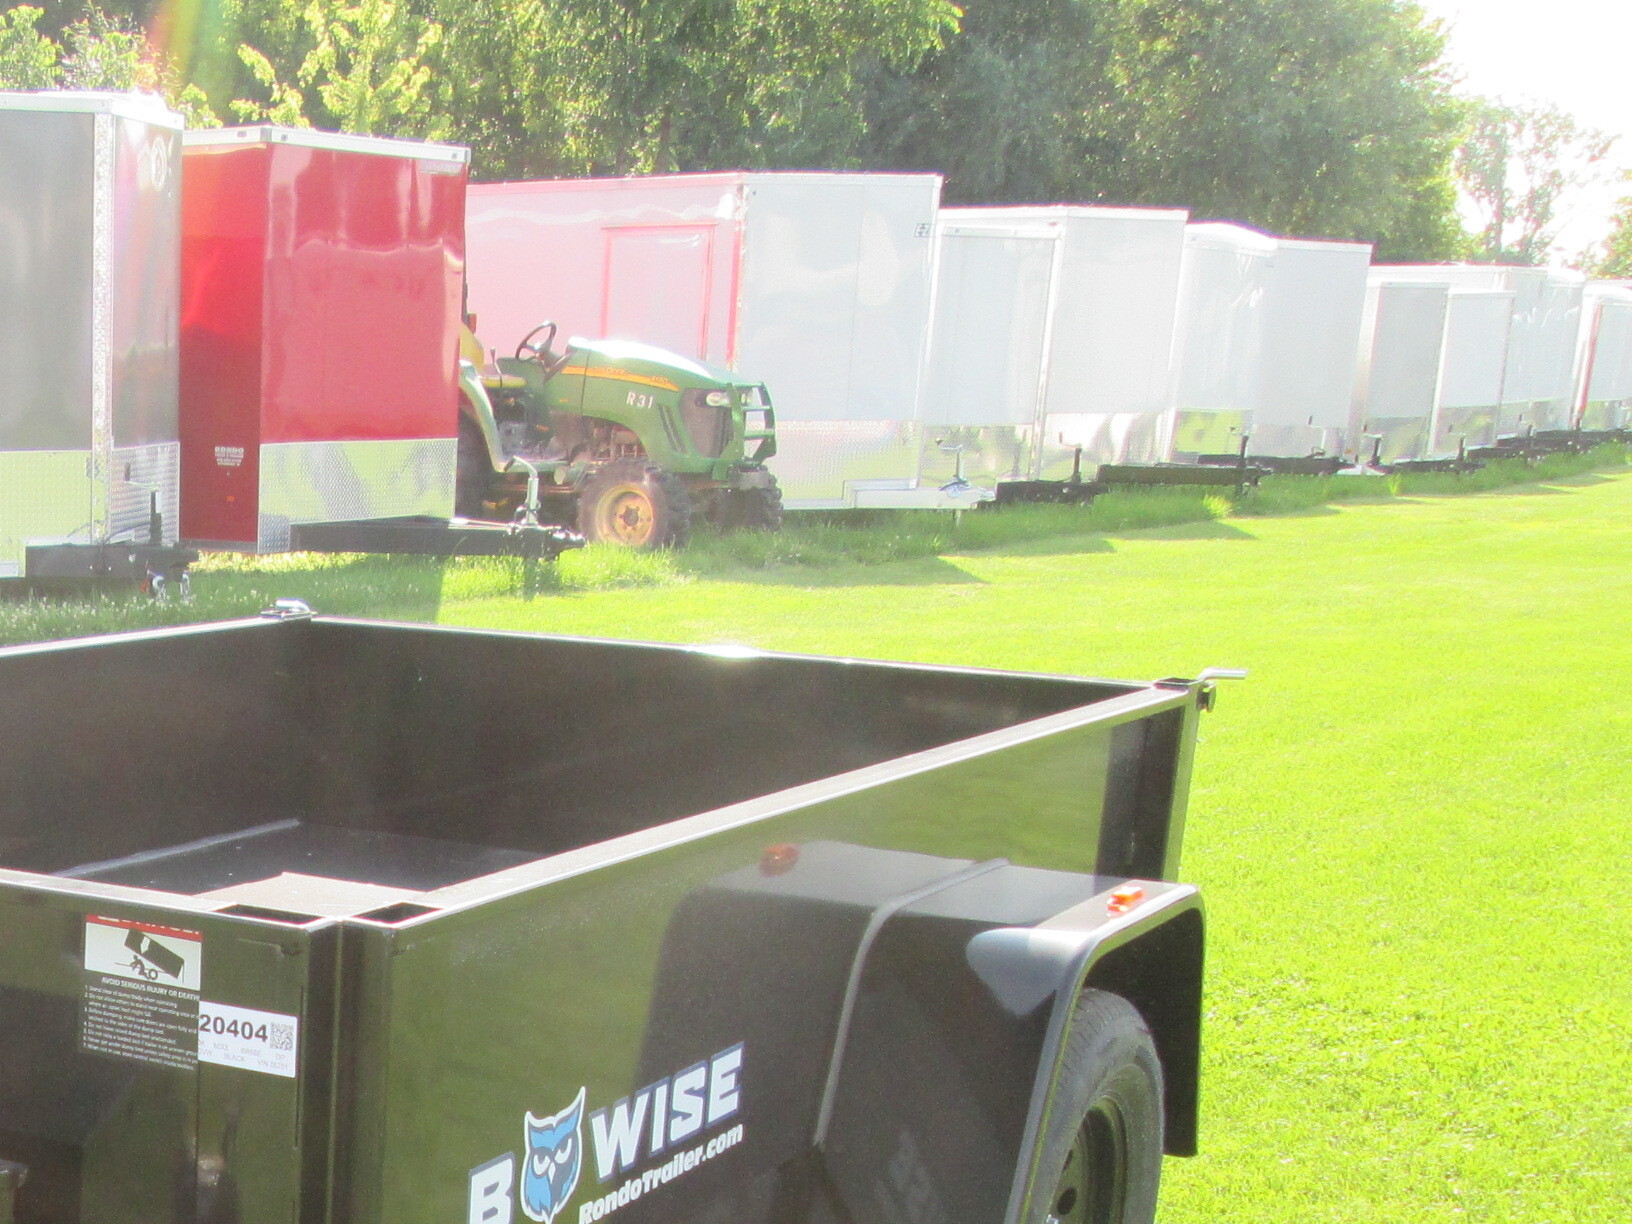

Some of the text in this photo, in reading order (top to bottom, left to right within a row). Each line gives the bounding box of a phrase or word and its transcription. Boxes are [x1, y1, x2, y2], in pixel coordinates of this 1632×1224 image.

[626, 391, 654, 409] R31
[101, 976, 120, 987] AVOID
[120, 980, 146, 991] SERIOUS
[146, 985, 168, 995] INJURY
[168, 989, 178, 998] OR
[199, 1014, 269, 1043] 20404
[224, 1053, 246, 1062] BLACK
[258, 1059, 269, 1067] VIN
